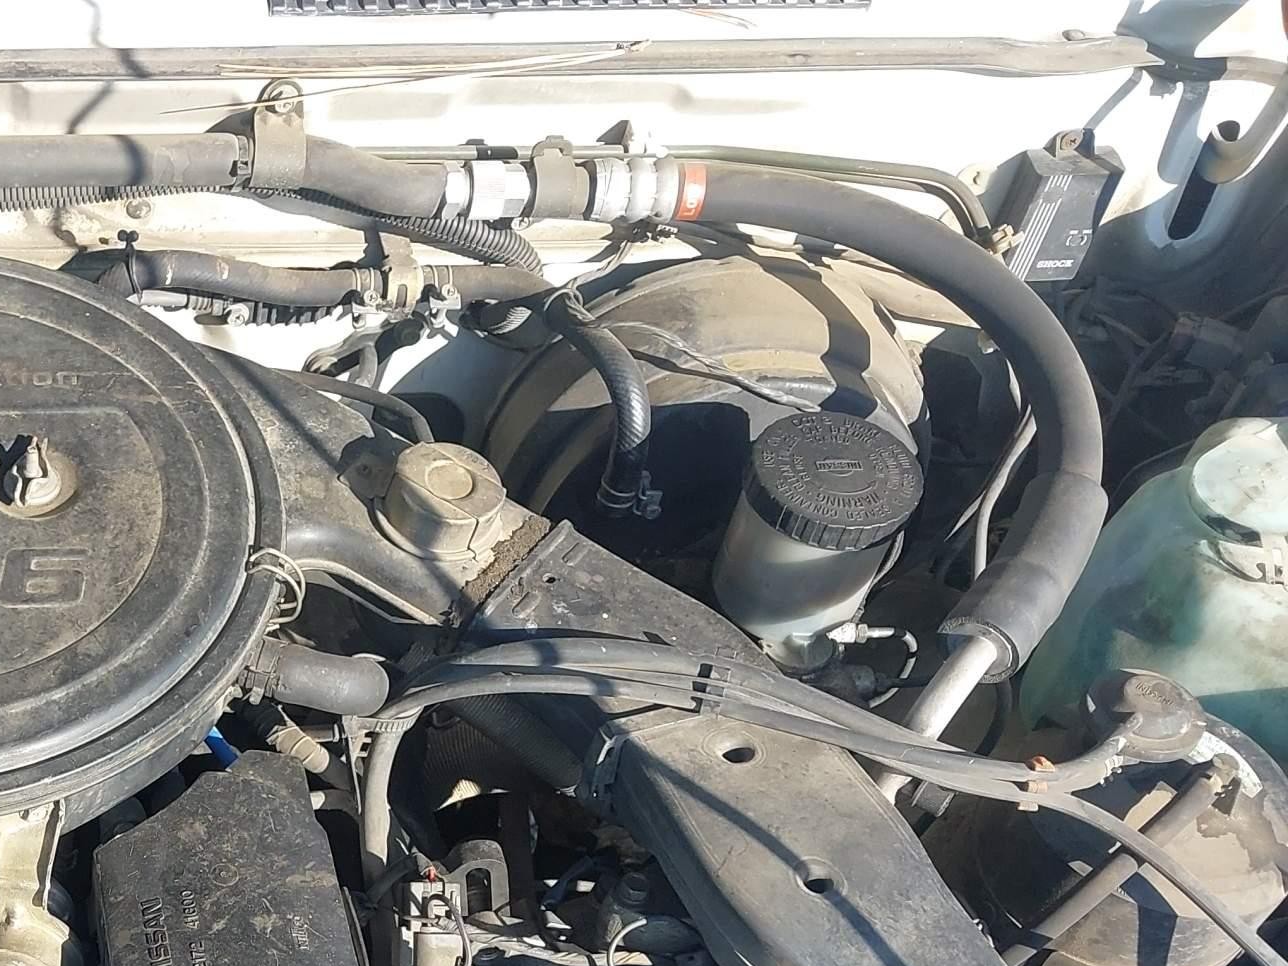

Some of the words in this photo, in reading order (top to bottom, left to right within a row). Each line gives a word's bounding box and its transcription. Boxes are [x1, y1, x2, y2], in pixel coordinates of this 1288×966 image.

[1036, 259, 1074, 268] SHOCK
[815, 491, 879, 509] WARNING
[846, 503, 892, 521] SEALED
